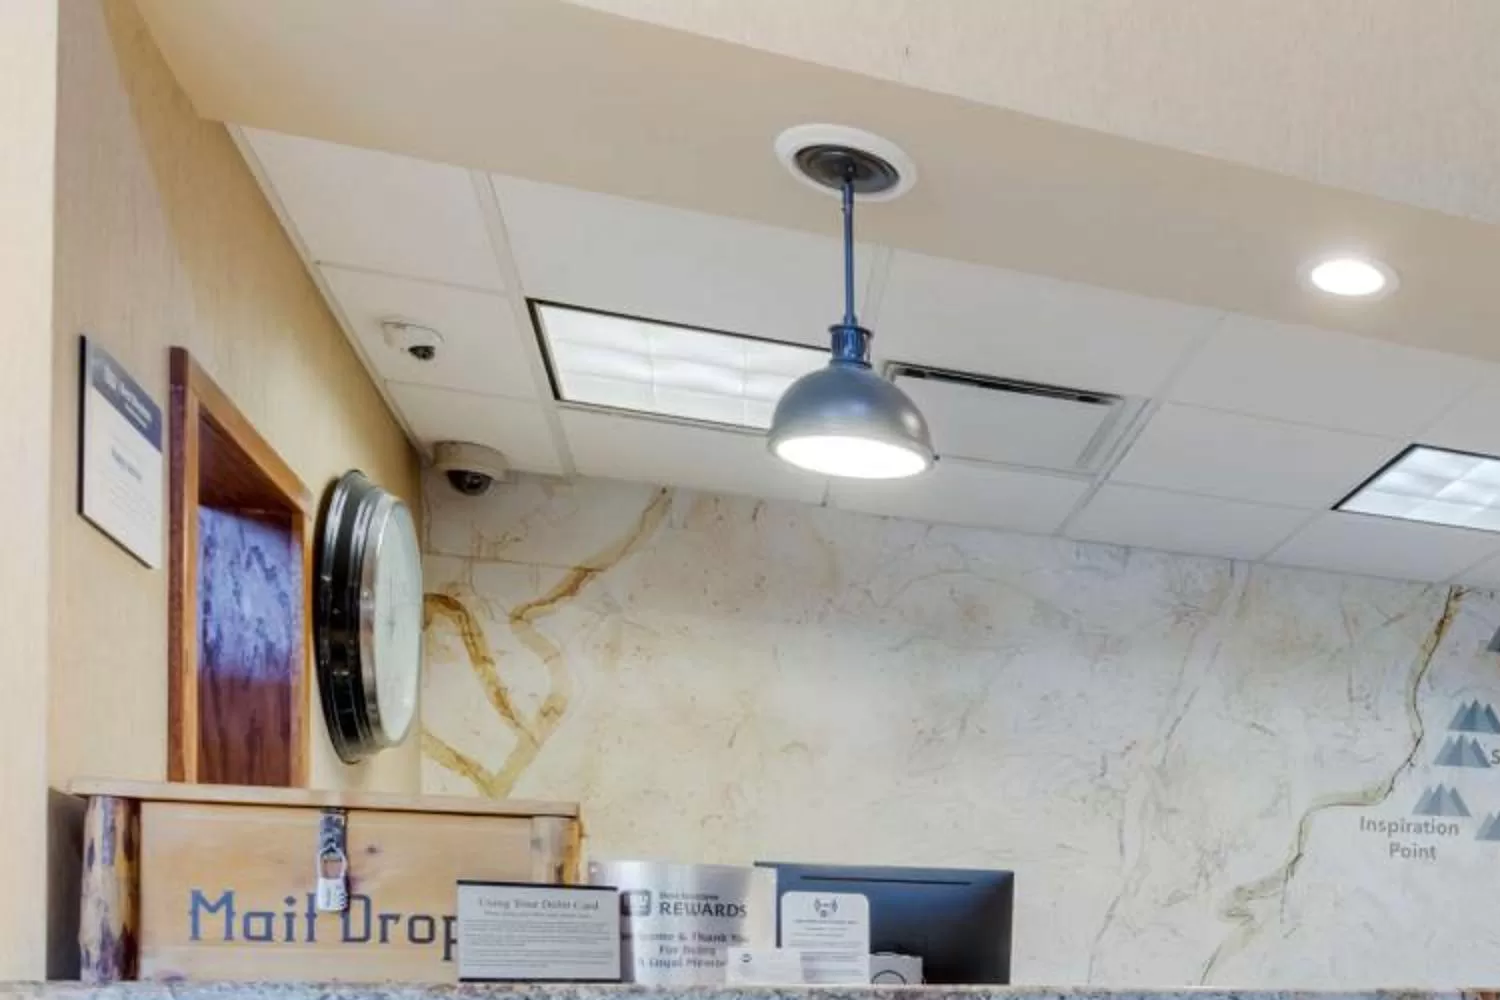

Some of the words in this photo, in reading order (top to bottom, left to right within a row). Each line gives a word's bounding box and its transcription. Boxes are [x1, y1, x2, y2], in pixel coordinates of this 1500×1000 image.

[1360, 815, 1460, 838] Inspiration
[1389, 843, 1437, 861] Point
[188, 889, 318, 942] Mail
[659, 901, 748, 918] REWARDS
